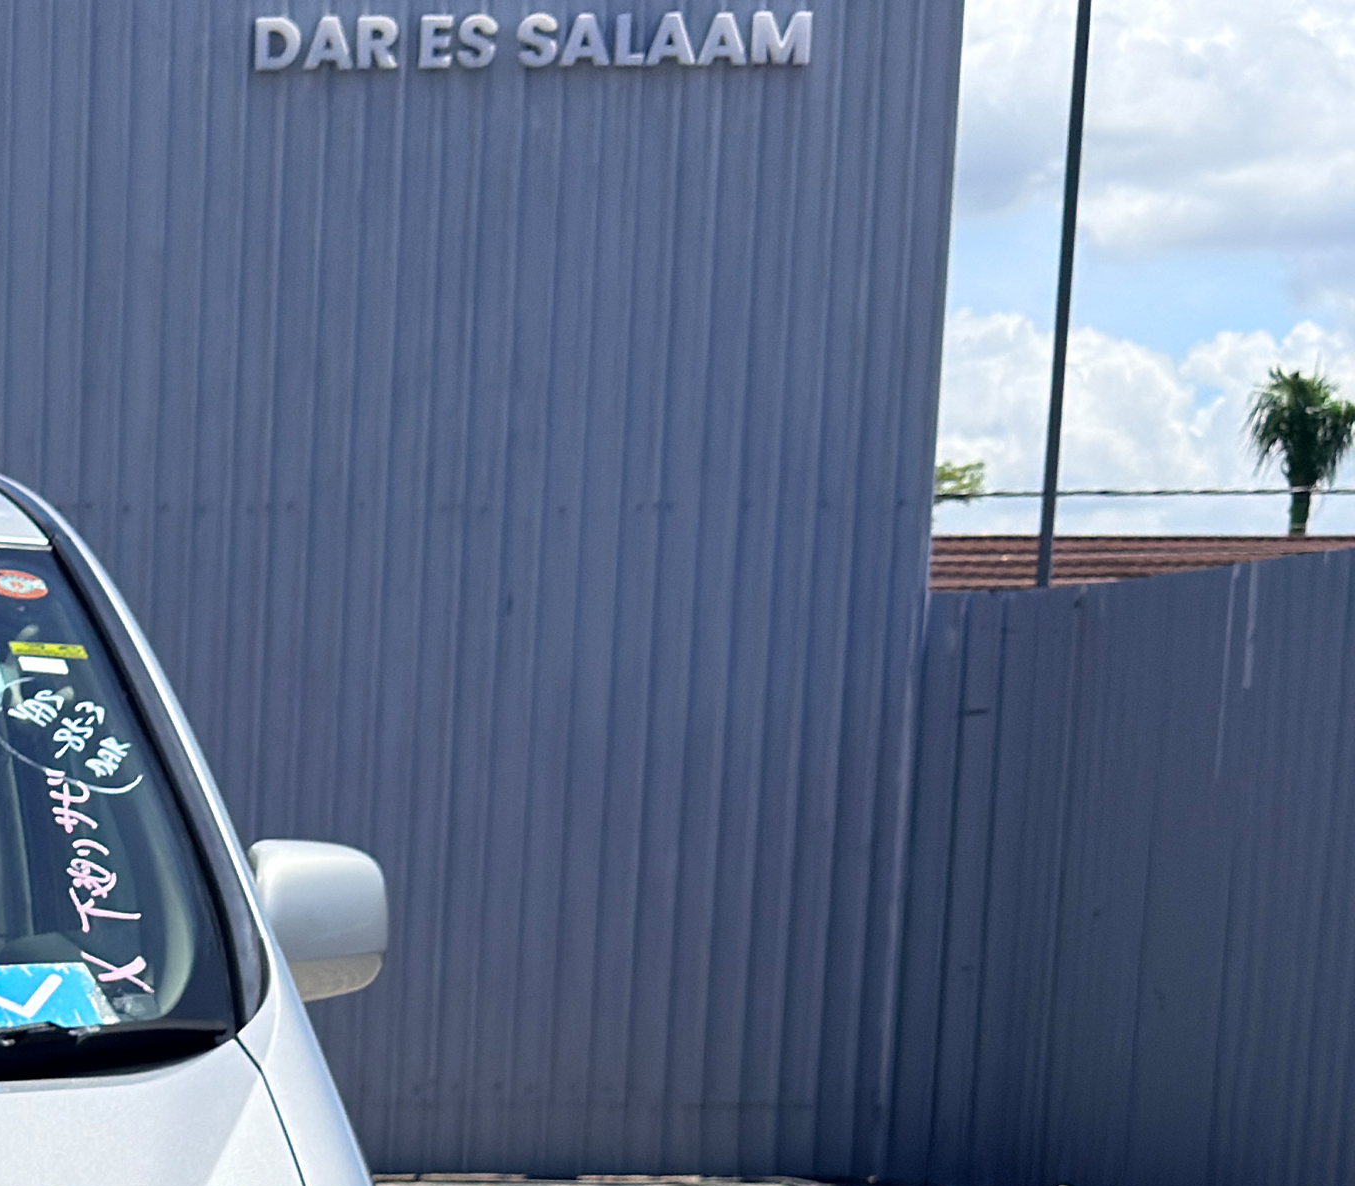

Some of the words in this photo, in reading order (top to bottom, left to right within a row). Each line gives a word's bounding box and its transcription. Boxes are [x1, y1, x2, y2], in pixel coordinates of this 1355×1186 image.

[254, 15, 399, 71] DAR
[418, 14, 498, 69] ES
[516, 10, 814, 69] SALAAM
